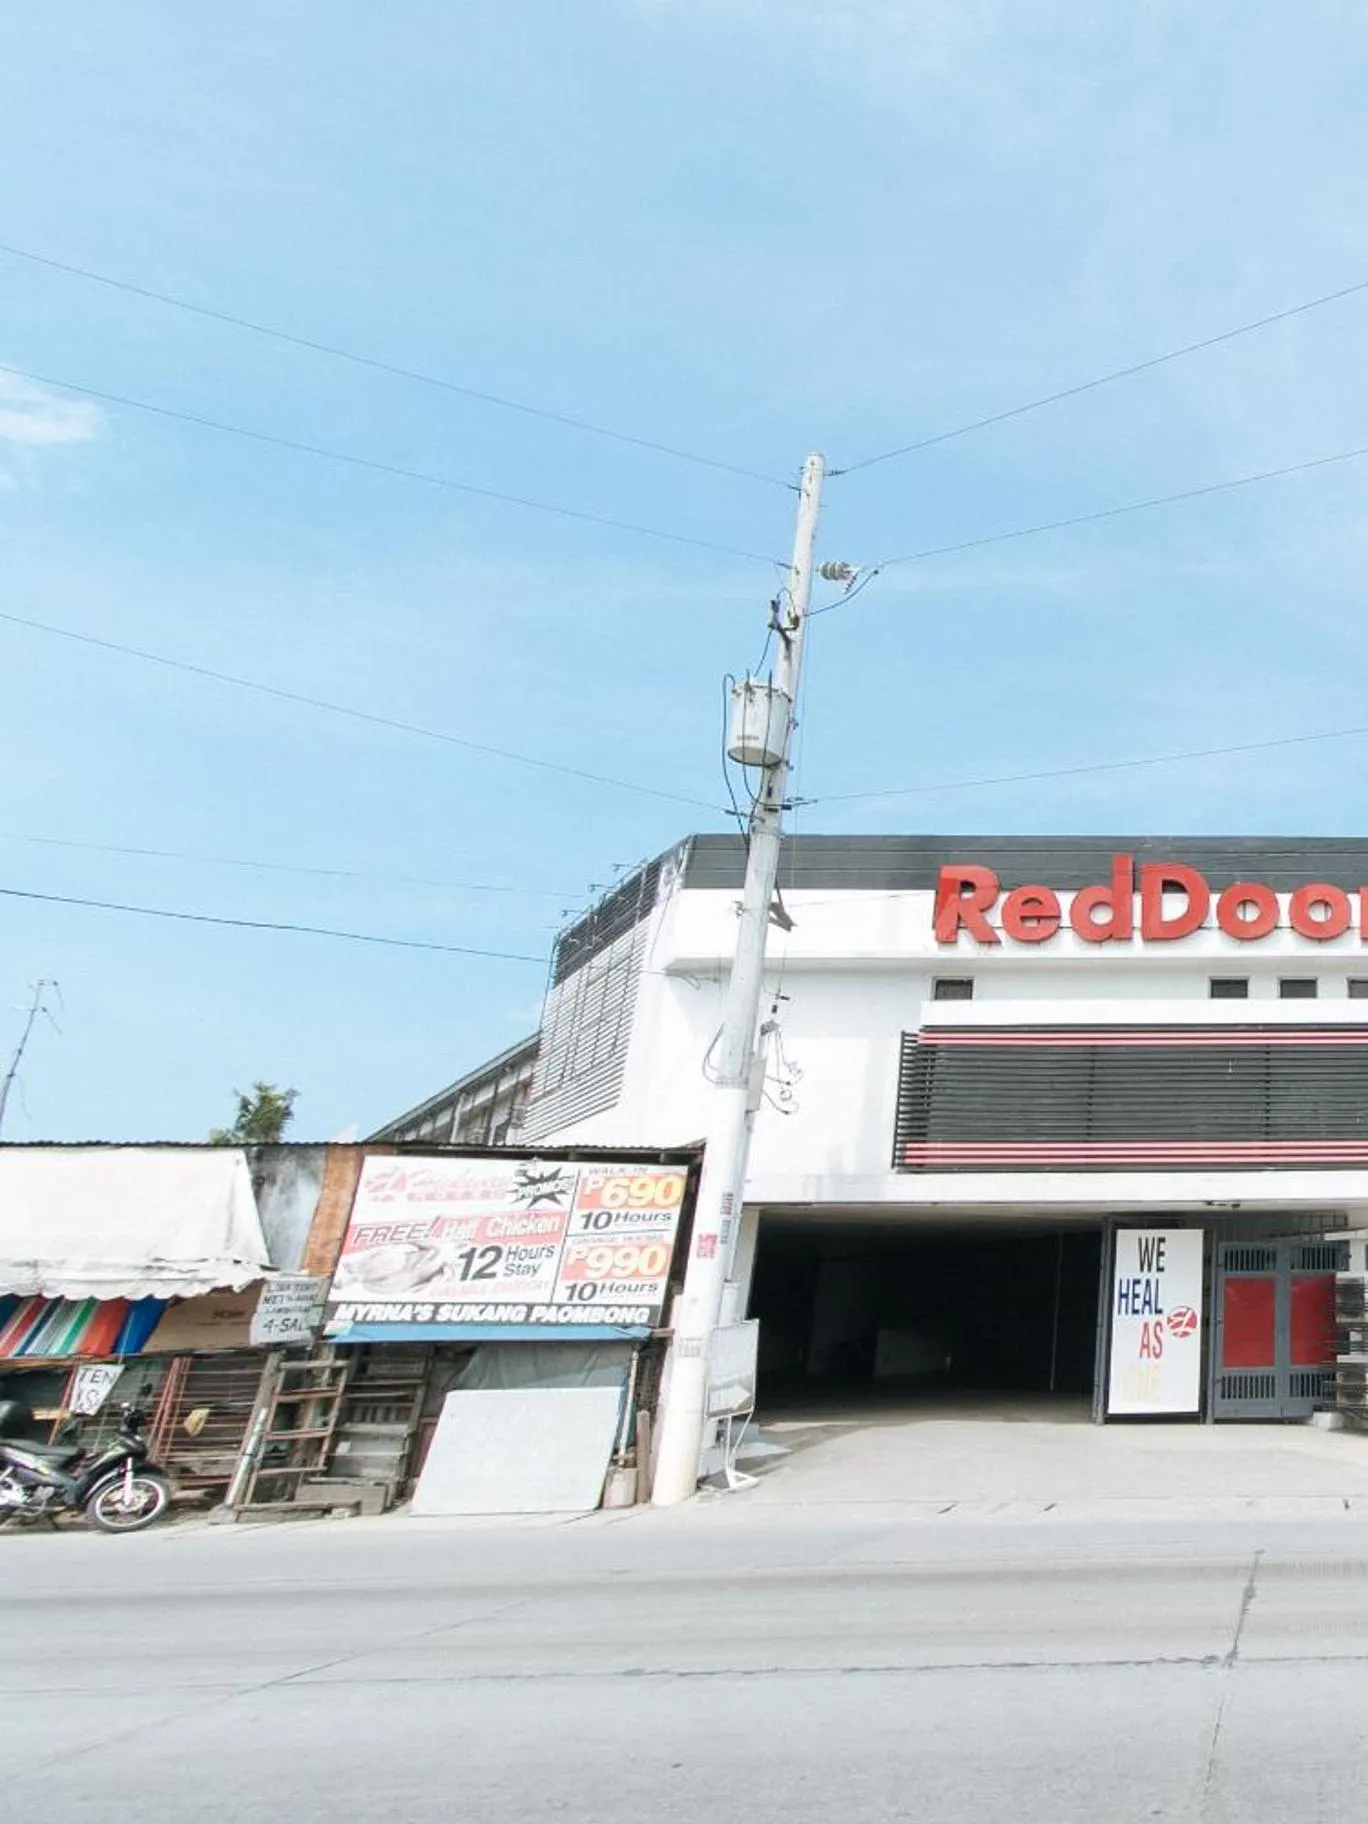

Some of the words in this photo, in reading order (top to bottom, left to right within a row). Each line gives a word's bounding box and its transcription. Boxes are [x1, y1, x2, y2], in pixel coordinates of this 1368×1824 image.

[352, 1216, 441, 1245] FREE!
[486, 1212, 561, 1238] Chicken
[579, 1211, 613, 1231] 10
[613, 1211, 673, 1223] Hours
[458, 1245, 501, 1281] 12
[505, 1244, 555, 1261] Hours
[503, 1262, 540, 1278] Stay
[1138, 1236, 1166, 1272] WE
[565, 1283, 598, 1302] 10
[599, 1282, 658, 1296] Hours
[1117, 1278, 1163, 1315] HEAL
[334, 1304, 433, 1321] MYRNA'S
[436, 1304, 524, 1322] SUKANG
[529, 1305, 650, 1324] PAOMBONG
[1139, 1321, 1163, 1359] AS
